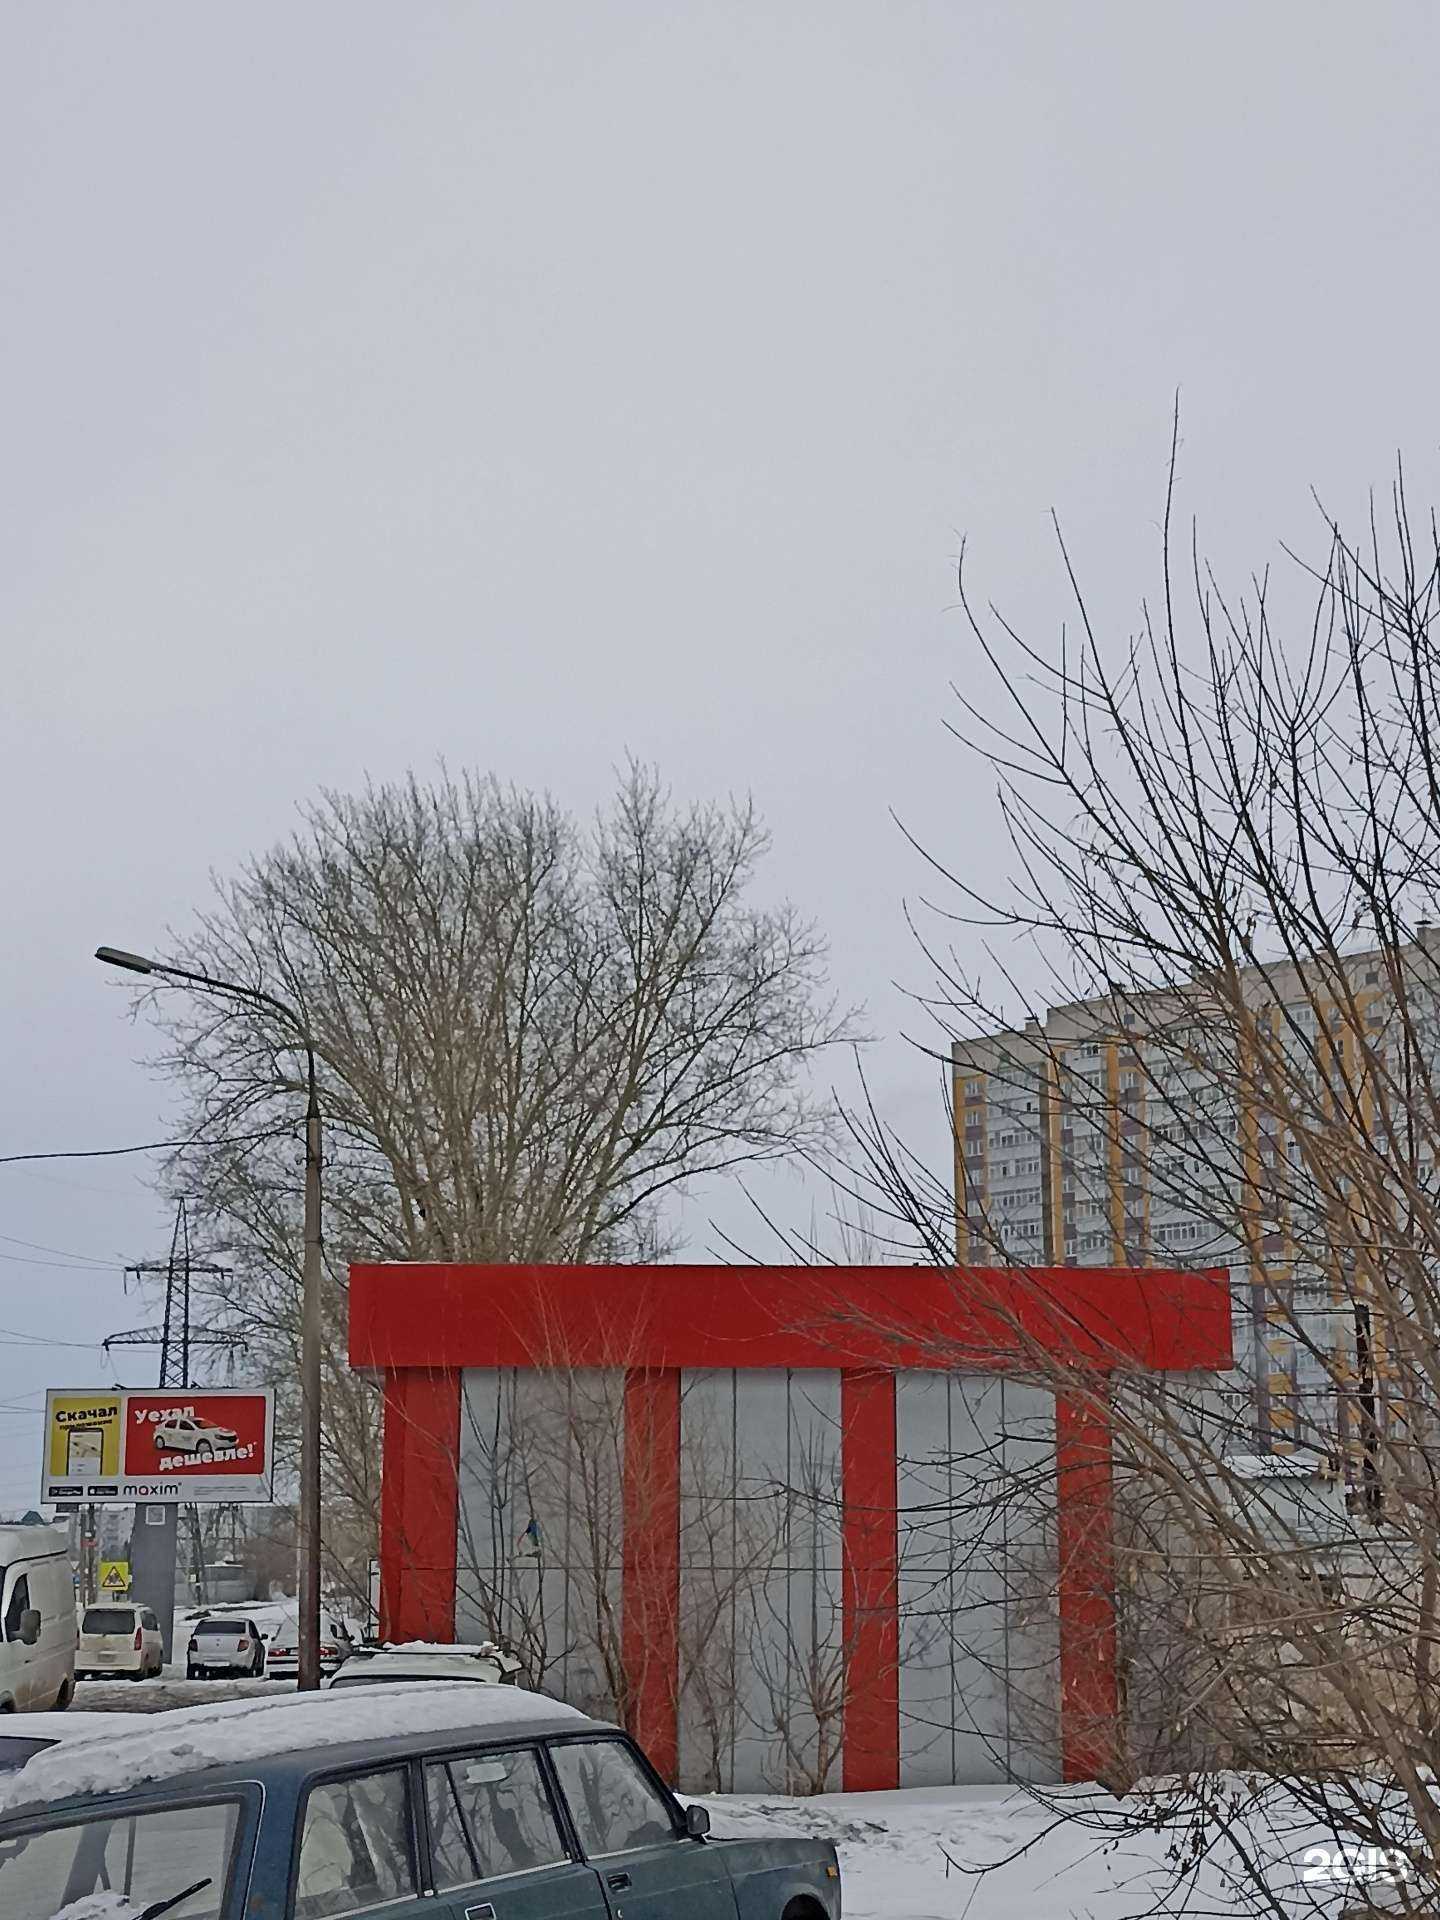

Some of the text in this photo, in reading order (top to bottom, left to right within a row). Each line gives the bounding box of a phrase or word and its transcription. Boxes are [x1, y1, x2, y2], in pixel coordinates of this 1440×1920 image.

[55, 1406, 118, 1423] Скачал
[134, 1406, 195, 1425] Уехал
[123, 1481, 179, 1496] maxim
